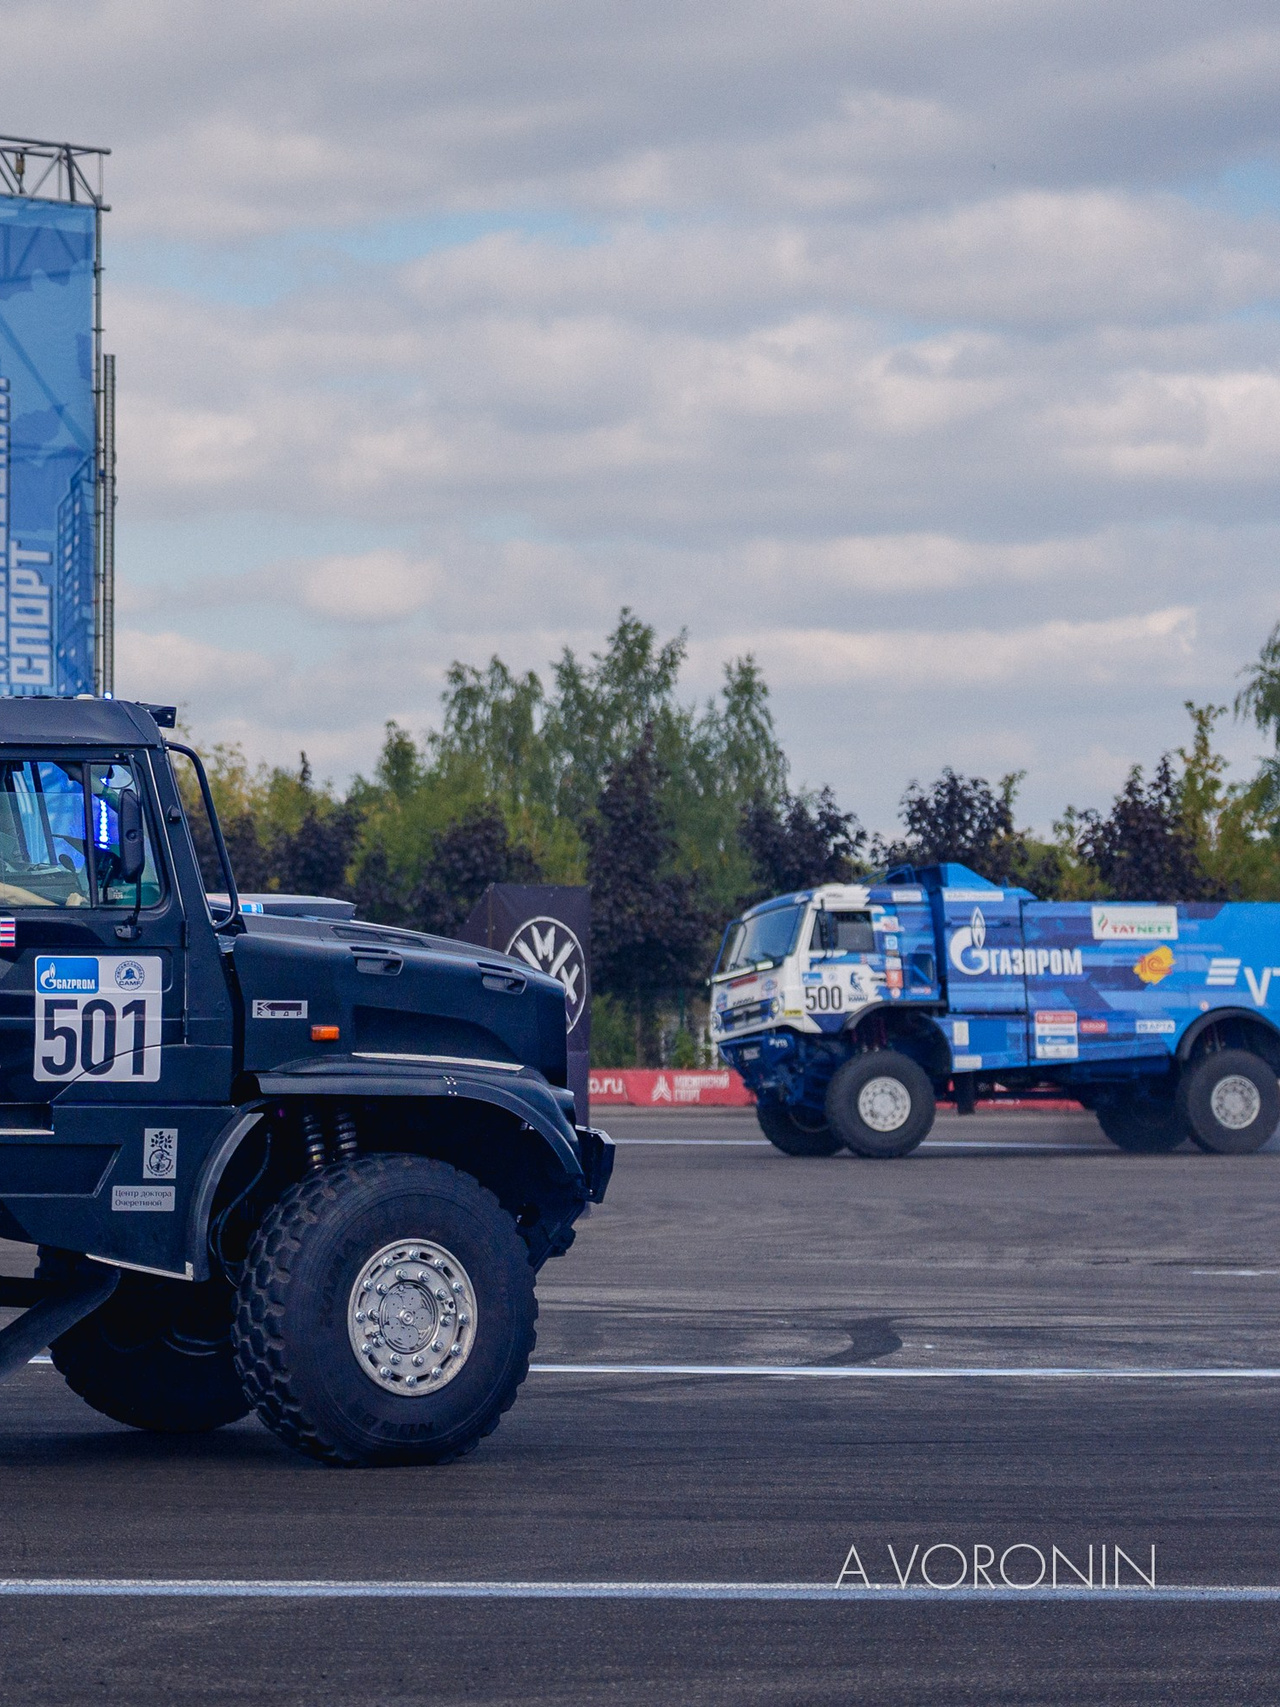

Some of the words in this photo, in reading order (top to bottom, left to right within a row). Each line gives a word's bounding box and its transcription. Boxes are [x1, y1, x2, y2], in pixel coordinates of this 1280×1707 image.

[9, 540, 53, 686] СПОРТ
[989, 948, 1083, 975] ГАЗПРОМ
[56, 978, 96, 990] GAZPROM
[805, 986, 842, 1011] 500
[41, 999, 147, 1076] 501
[115, 1190, 139, 1198] Центр
[140, 1190, 172, 1198] доктора
